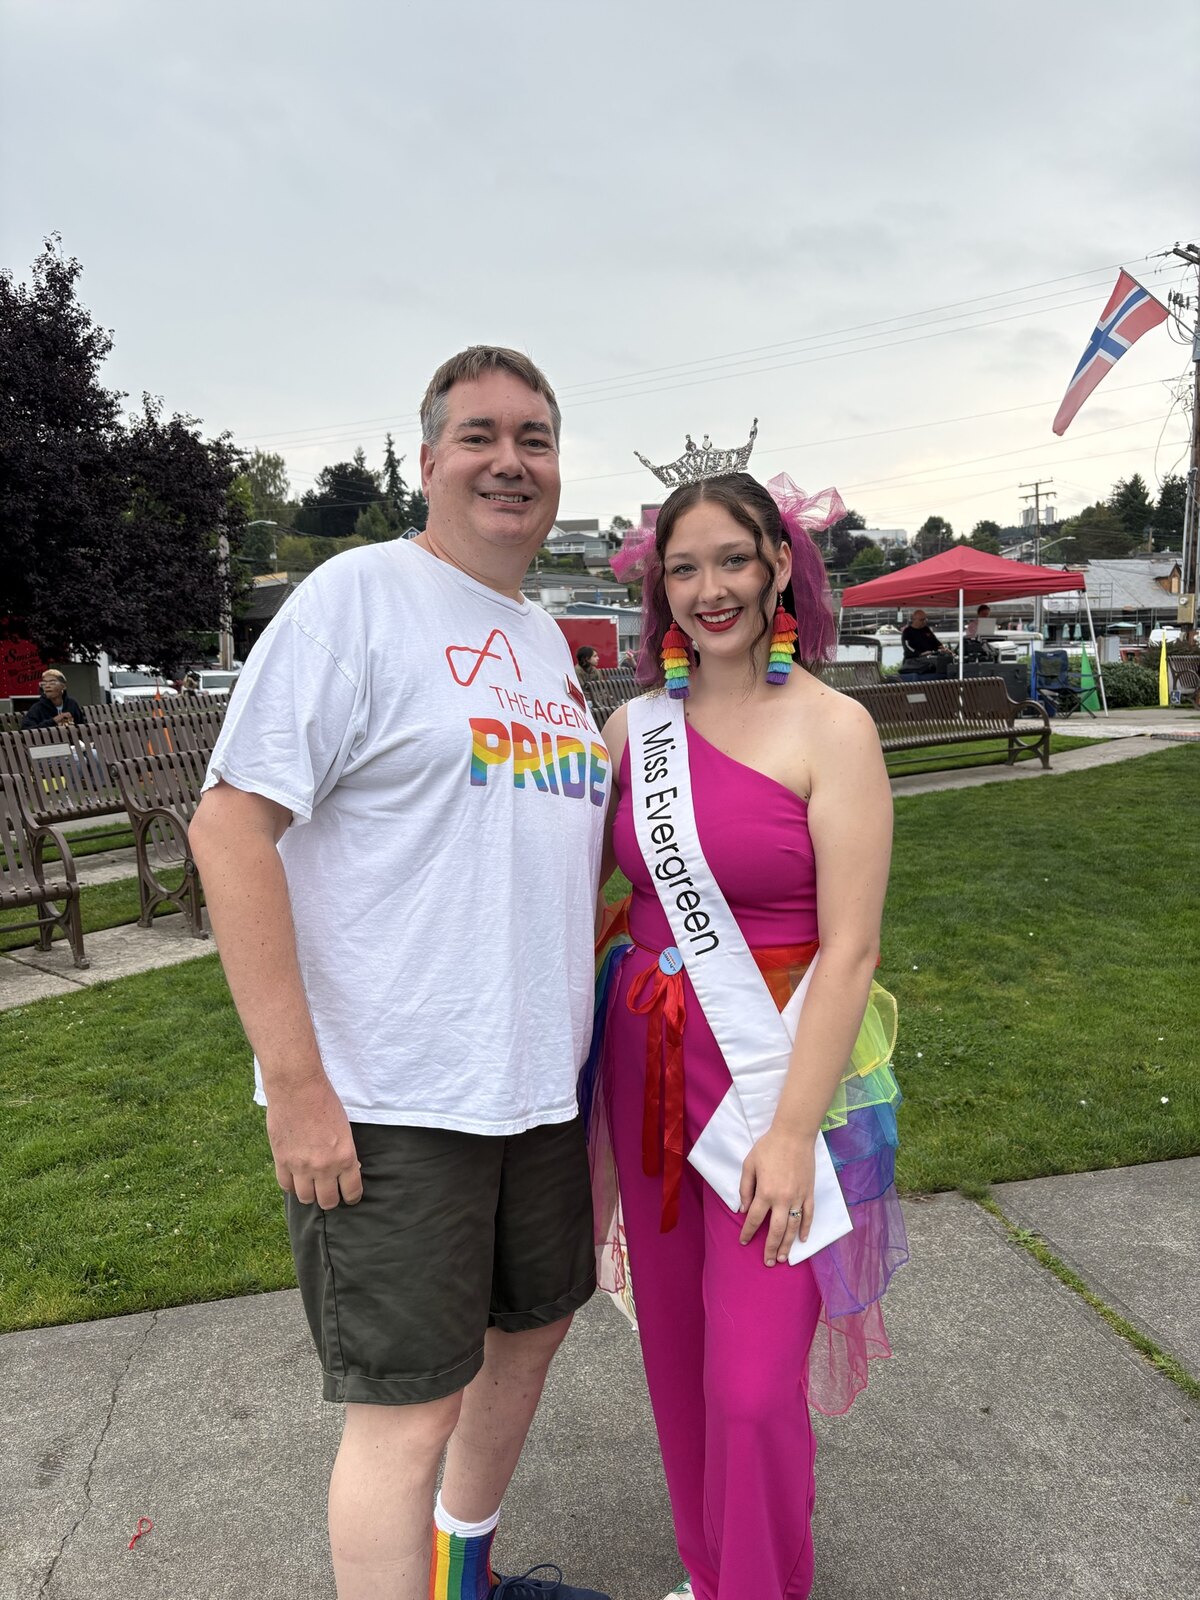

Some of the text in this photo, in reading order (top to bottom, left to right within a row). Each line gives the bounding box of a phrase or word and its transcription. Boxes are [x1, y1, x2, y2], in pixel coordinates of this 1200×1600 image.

[468, 717, 609, 808] PRIDE
[642, 721, 720, 956] Miss Evergreen
